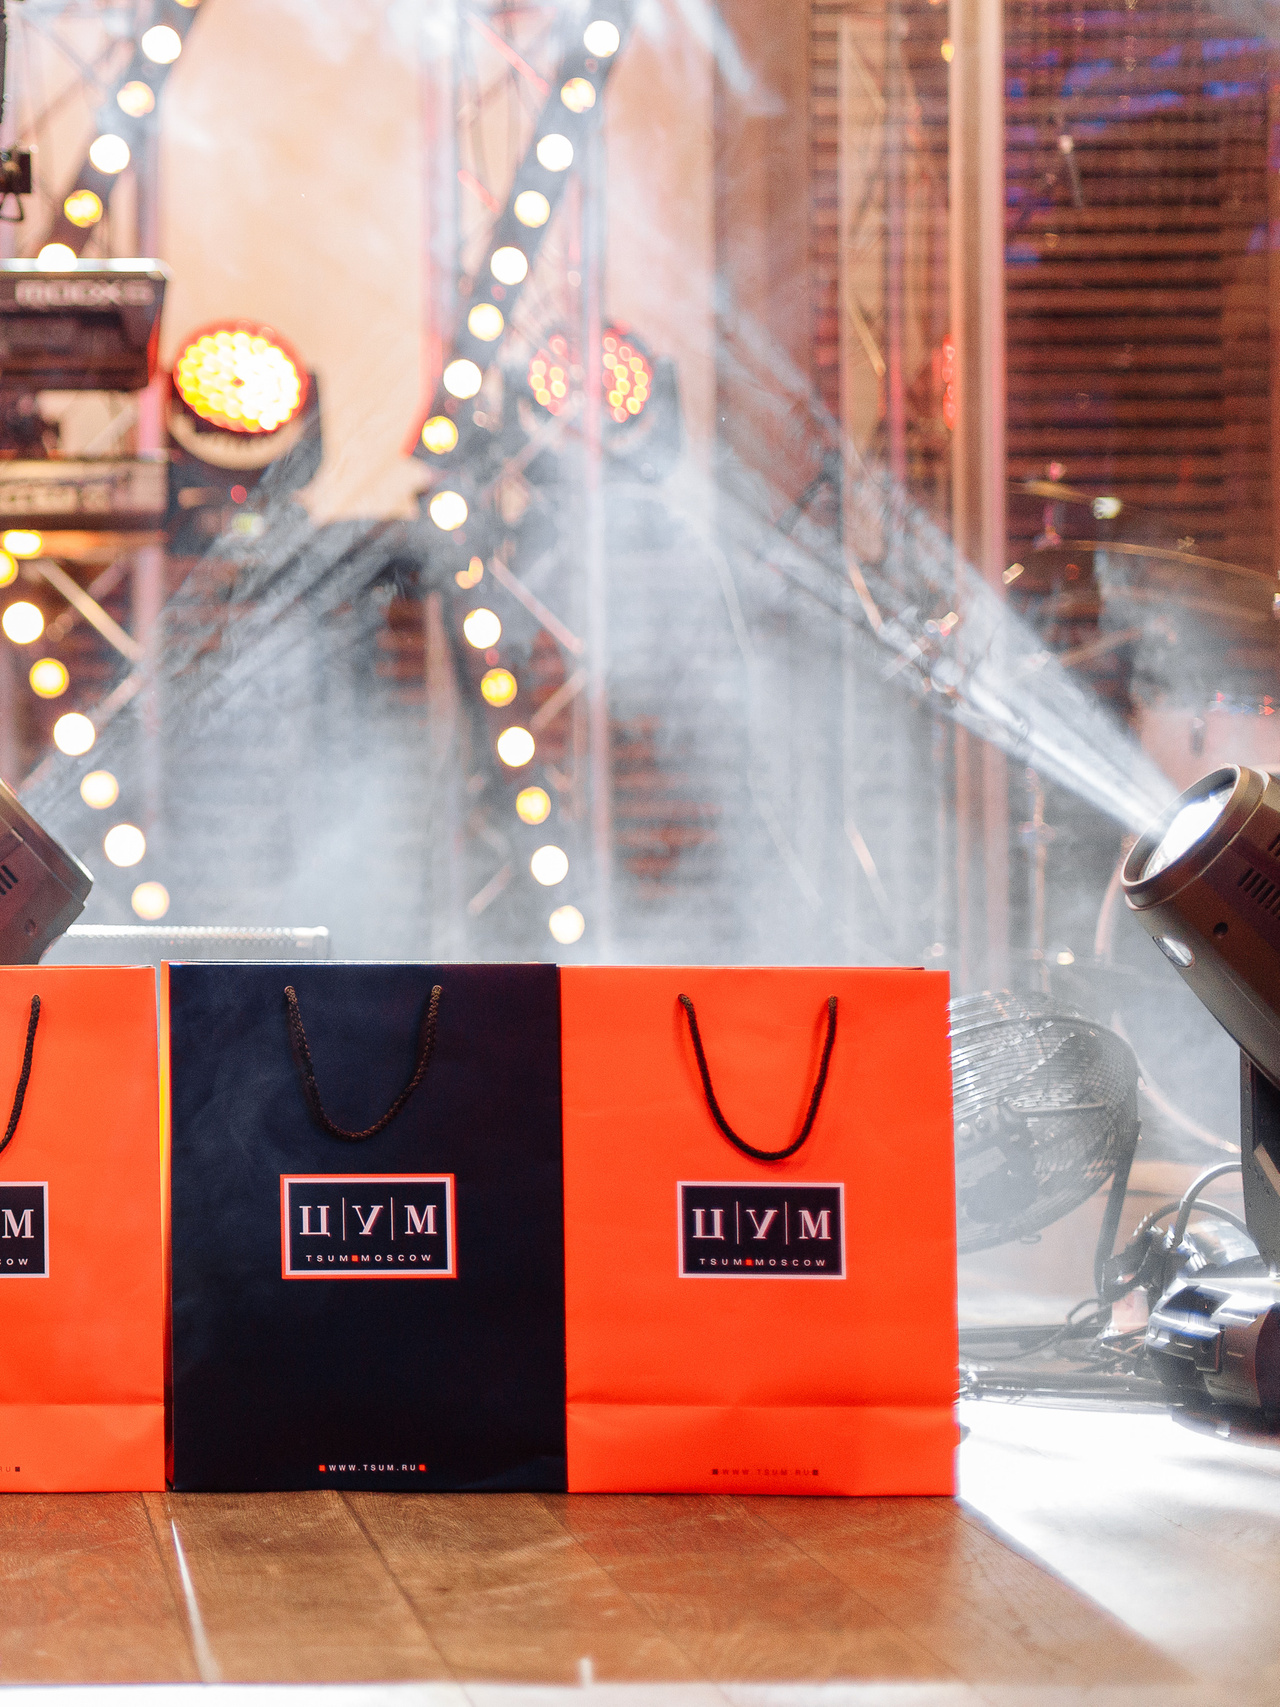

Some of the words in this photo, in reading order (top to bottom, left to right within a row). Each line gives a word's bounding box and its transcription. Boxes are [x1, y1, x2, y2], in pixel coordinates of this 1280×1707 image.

[298, 1204, 438, 1237] ЦУМ
[692, 1208, 831, 1241] ЦУМ
[305, 1254, 348, 1262] TSUM
[360, 1254, 431, 1262] MOSCOW
[699, 1258, 742, 1266] TSUM
[755, 1258, 825, 1267] MOSCOW
[328, 1464, 416, 1472] WWW.TSUM.RU
